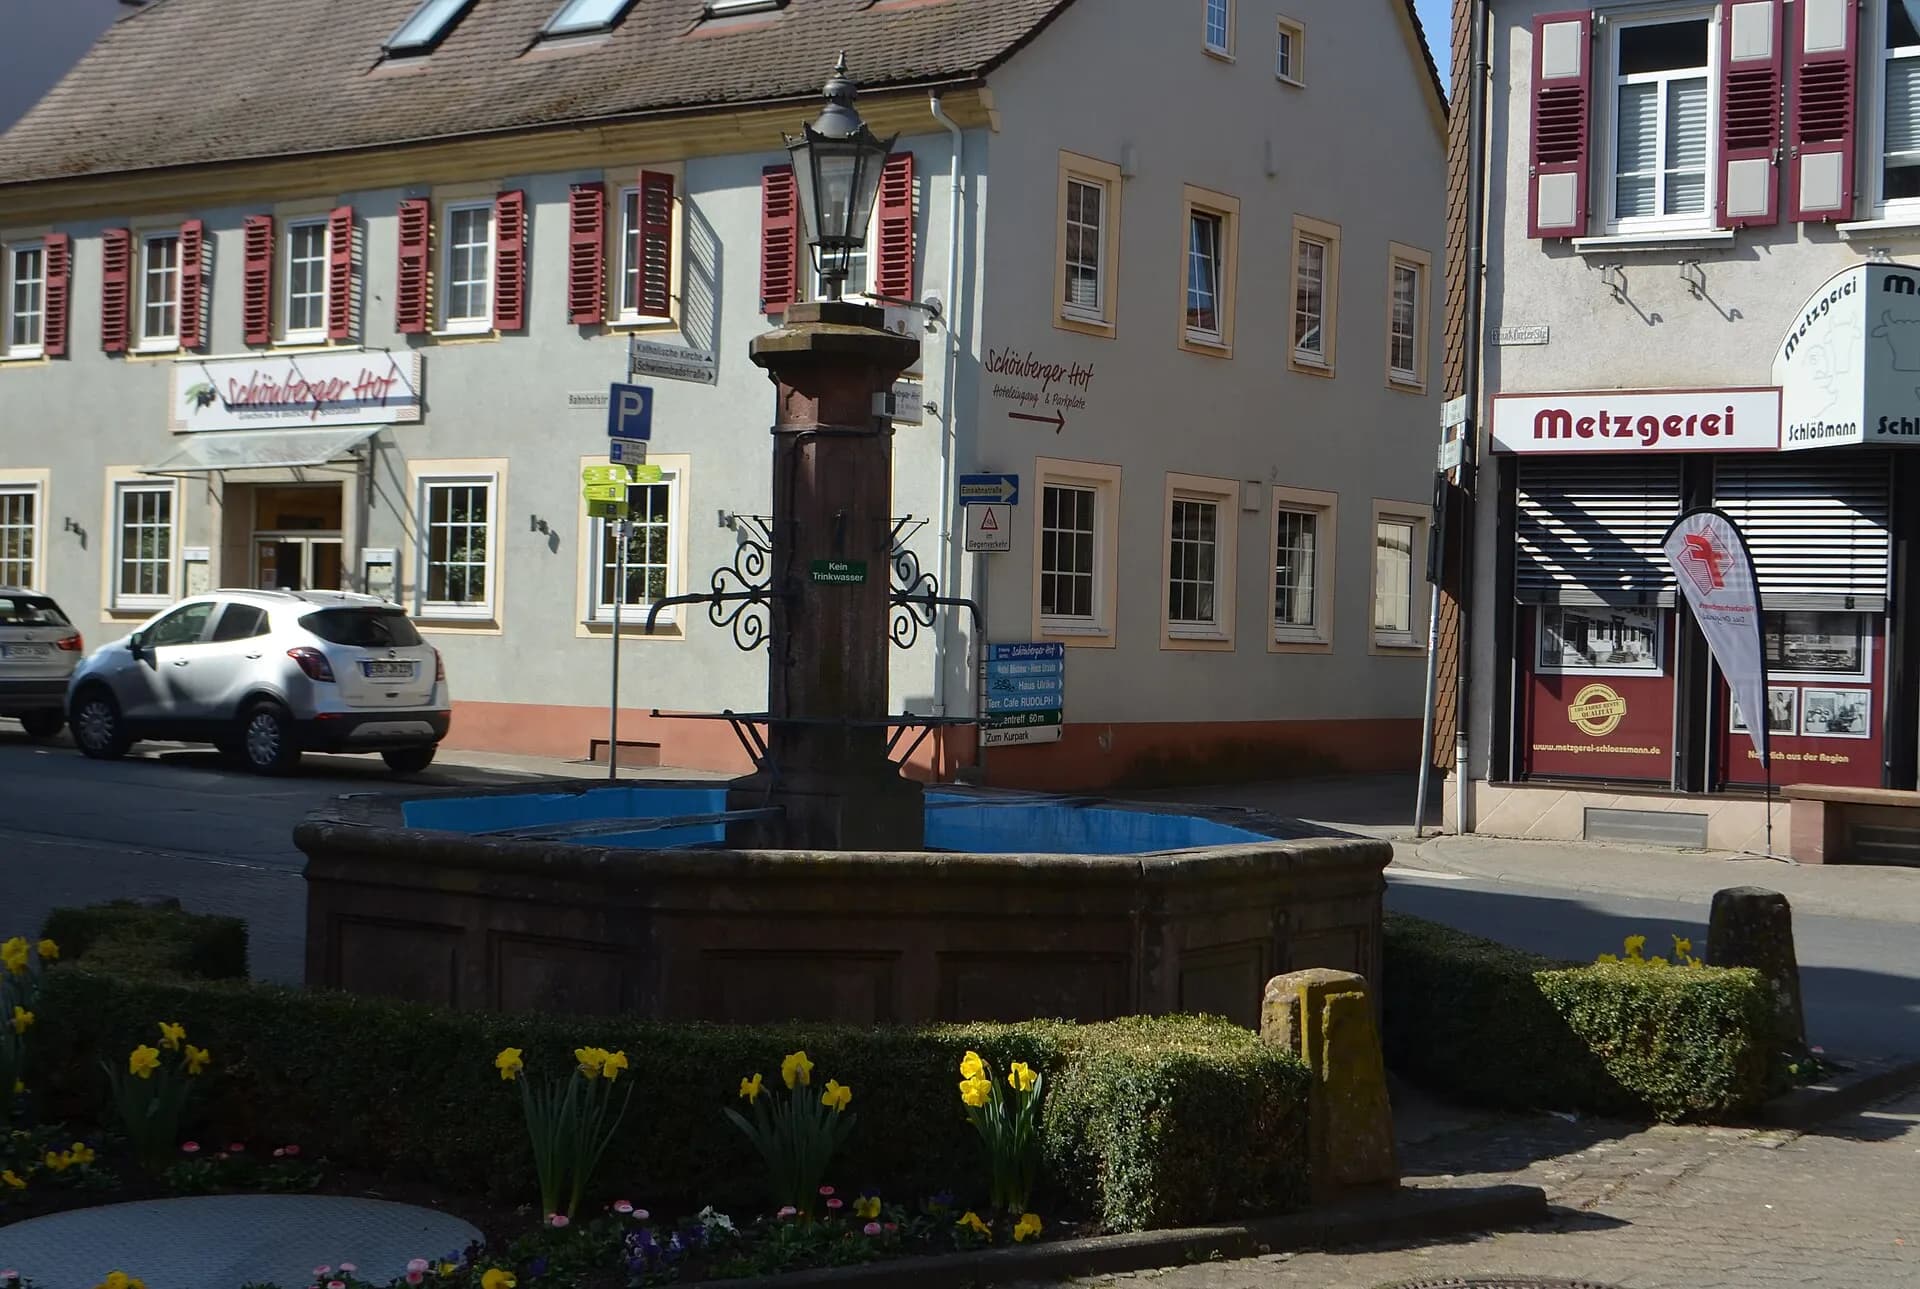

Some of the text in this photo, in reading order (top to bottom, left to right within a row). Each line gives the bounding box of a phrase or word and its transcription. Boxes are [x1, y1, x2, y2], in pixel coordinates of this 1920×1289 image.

[1883, 274, 1920, 296] M
[1785, 276, 1856, 360] Metzgerei
[637, 343, 703, 361] Katholische Kirche
[985, 347, 1094, 392] Schönberger Hof
[228, 363, 398, 421] Schönberger Hof
[617, 390, 643, 432] P
[1534, 405, 1734, 447] Metzgerei
[1788, 421, 1856, 442] Schlößmann
[969, 540, 1008, 549] Gegenverkehr
[828, 562, 848, 571] Kein
[812, 572, 864, 582] Trinkwasser
[1019, 681, 1036, 690] Haus
[1021, 695, 1054, 707] RUDOLPH
[1582, 708, 1613, 717] QUALITÄT
[986, 730, 1029, 743] Zum Kurpark
[1532, 743, 1661, 755] www.metzgerei-schloessmann.de
[1802, 752, 1818, 761] der
[1819, 753, 1849, 764] Region
